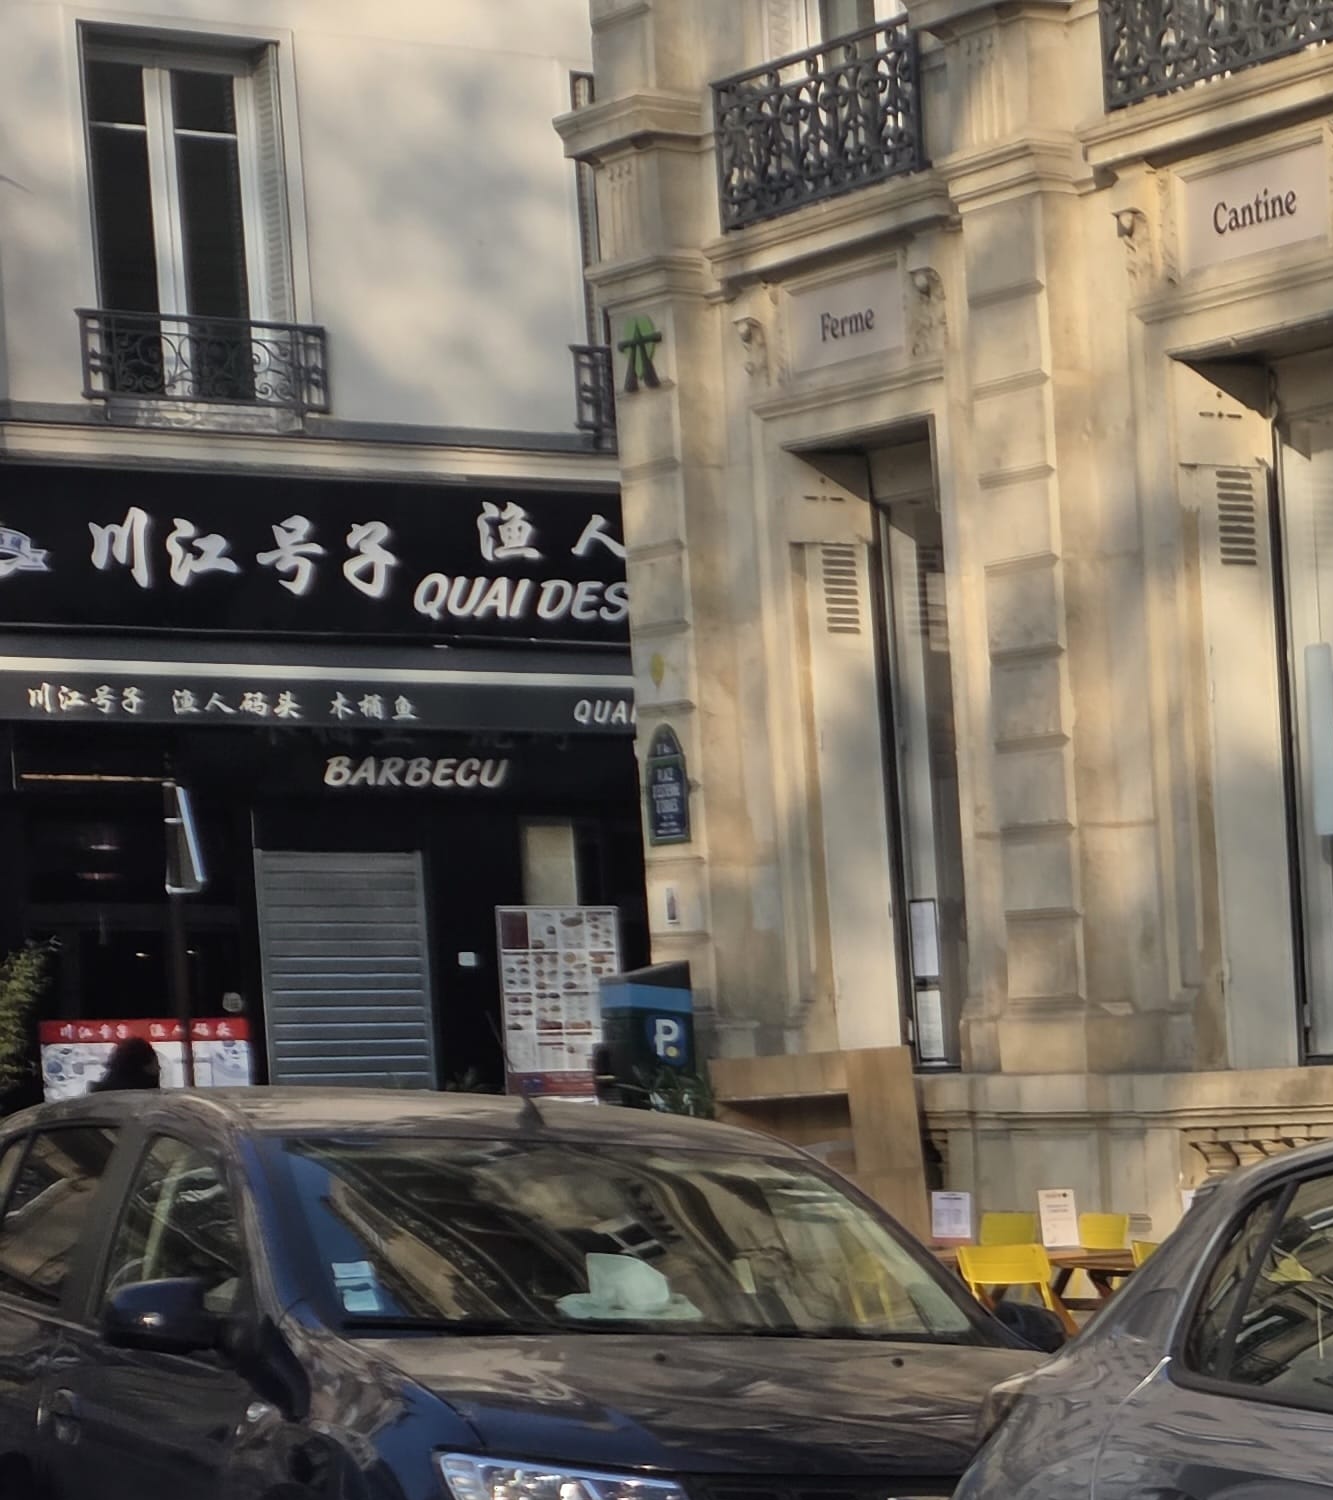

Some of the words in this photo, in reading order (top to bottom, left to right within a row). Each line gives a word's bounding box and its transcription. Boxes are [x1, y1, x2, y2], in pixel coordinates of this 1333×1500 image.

[1212, 187, 1297, 236] Cantine
[820, 304, 876, 342] Ferme
[88, 506, 398, 598] 川江号子
[414, 573, 530, 620] QUAI
[536, 579, 629, 621] DES
[28, 682, 143, 714] 川江号子
[324, 756, 509, 787] BARBECU
